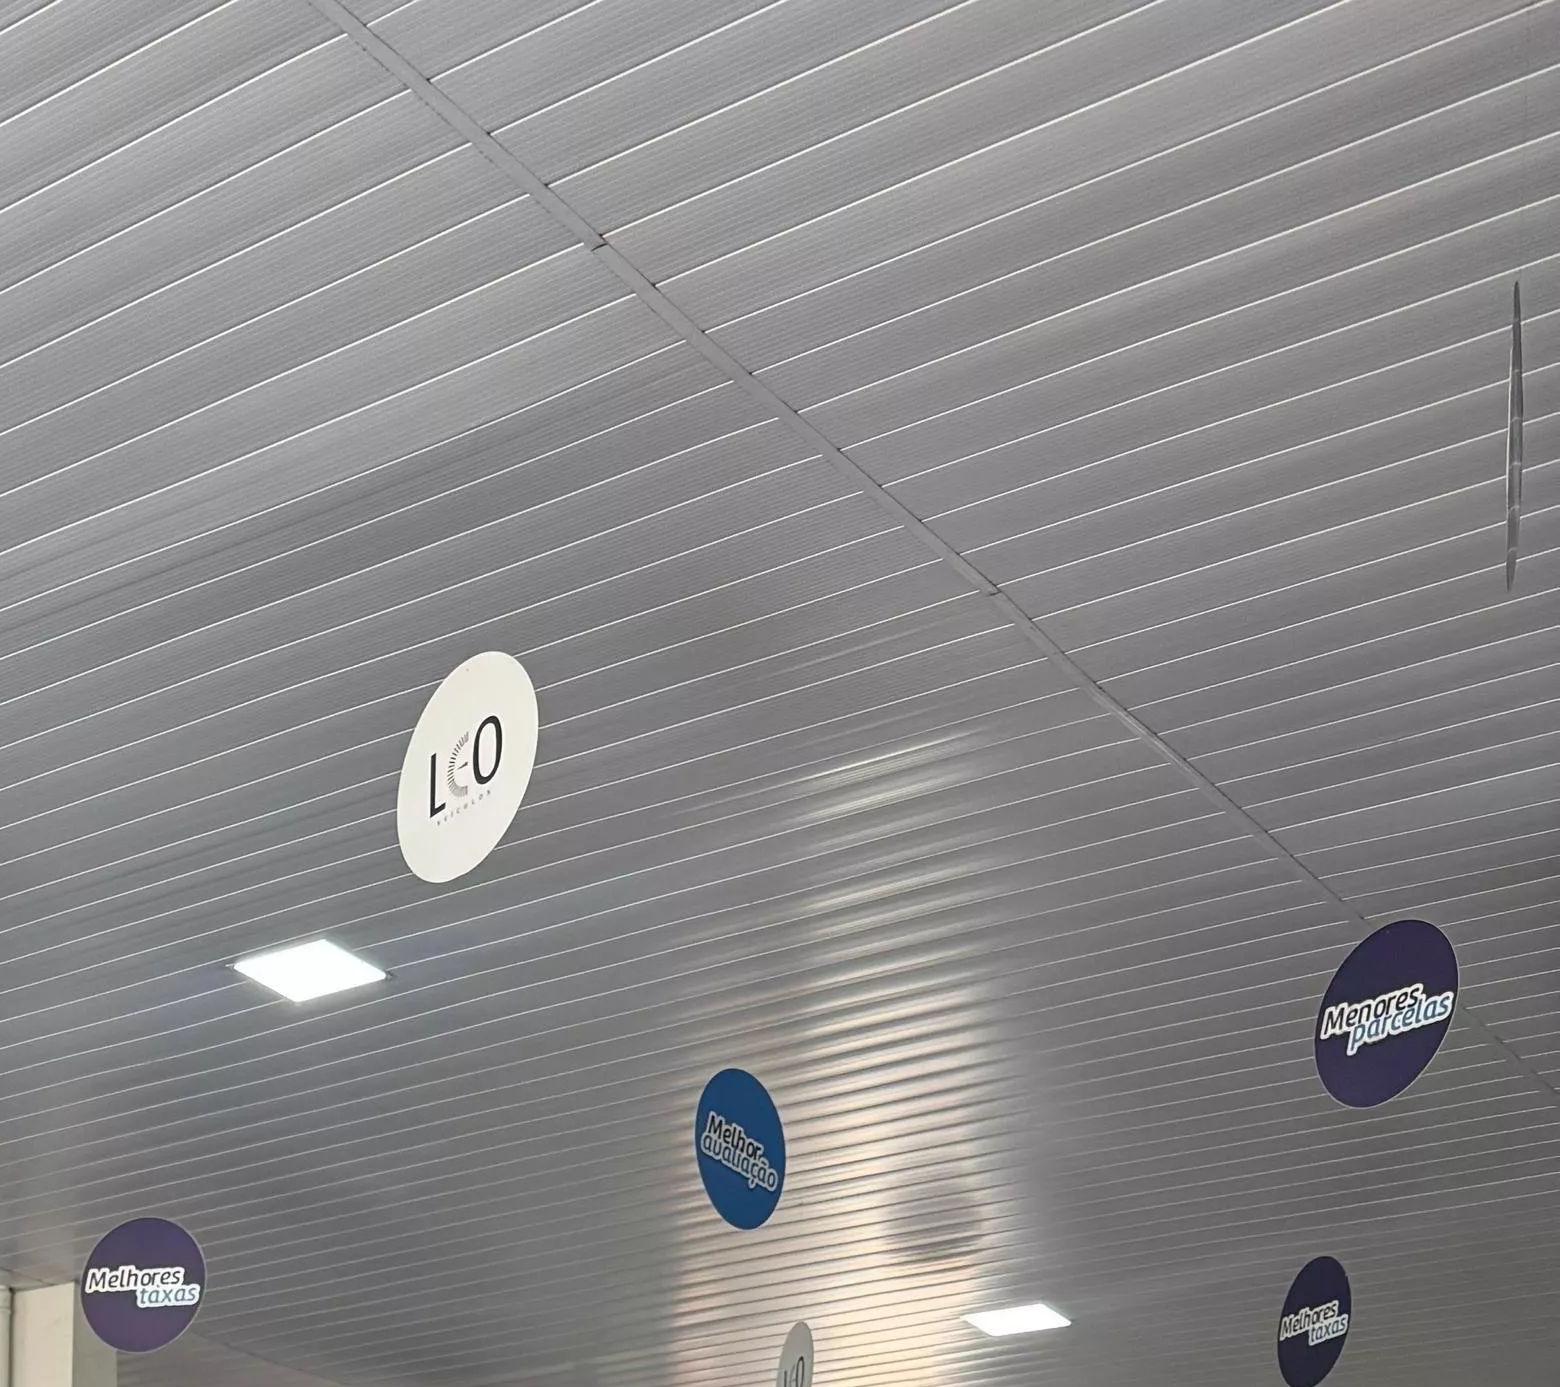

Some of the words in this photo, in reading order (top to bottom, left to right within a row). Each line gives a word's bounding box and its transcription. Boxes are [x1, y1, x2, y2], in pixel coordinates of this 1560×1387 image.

[1324, 986, 1421, 1036] Menores
[1351, 996, 1450, 1050] parcelas
[708, 1114, 762, 1159] Melhor
[702, 1134, 777, 1187] avaliação
[88, 1268, 182, 1290] Melhores
[139, 1286, 197, 1305] taxas
[1280, 1303, 1338, 1338] Melhores
[1310, 1316, 1346, 1344] taxas
